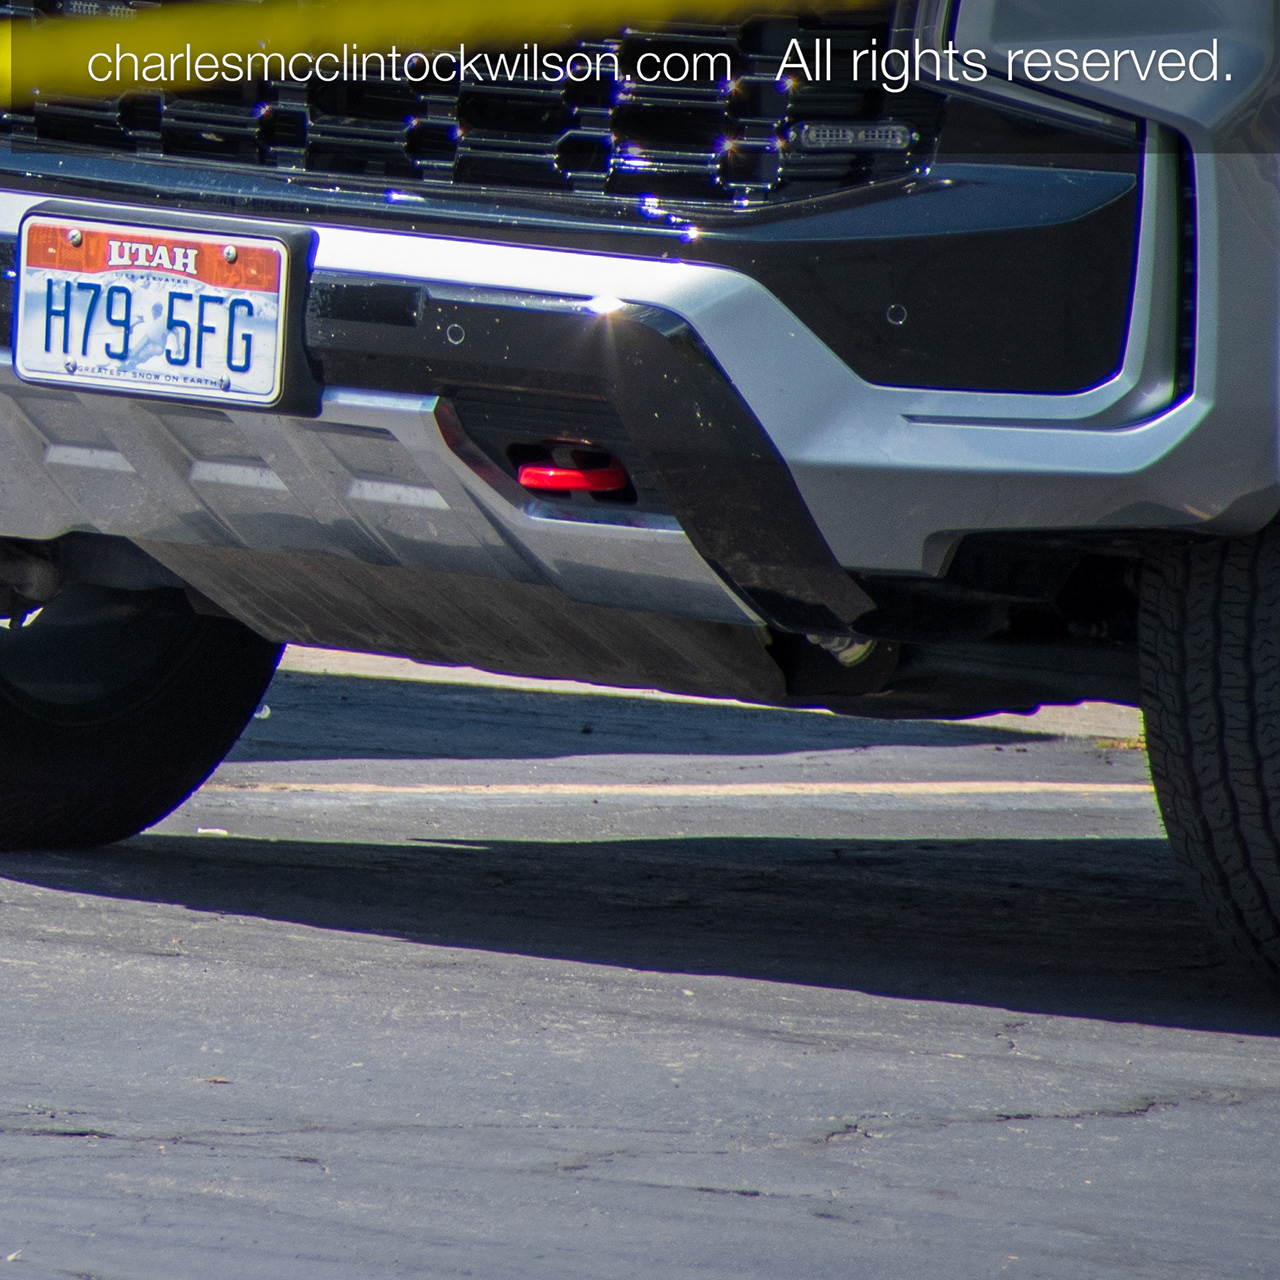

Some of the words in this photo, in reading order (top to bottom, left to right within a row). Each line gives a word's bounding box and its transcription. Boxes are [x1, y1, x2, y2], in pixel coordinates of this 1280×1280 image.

[108, 240, 198, 275] UTAH
[44, 278, 132, 361] H79
[165, 291, 254, 373] 5FG
[77, 365, 128, 377] GREATEST
[132, 371, 161, 381] SNOW
[165, 374, 179, 383] ON
[183, 376, 218, 387] EARTH
